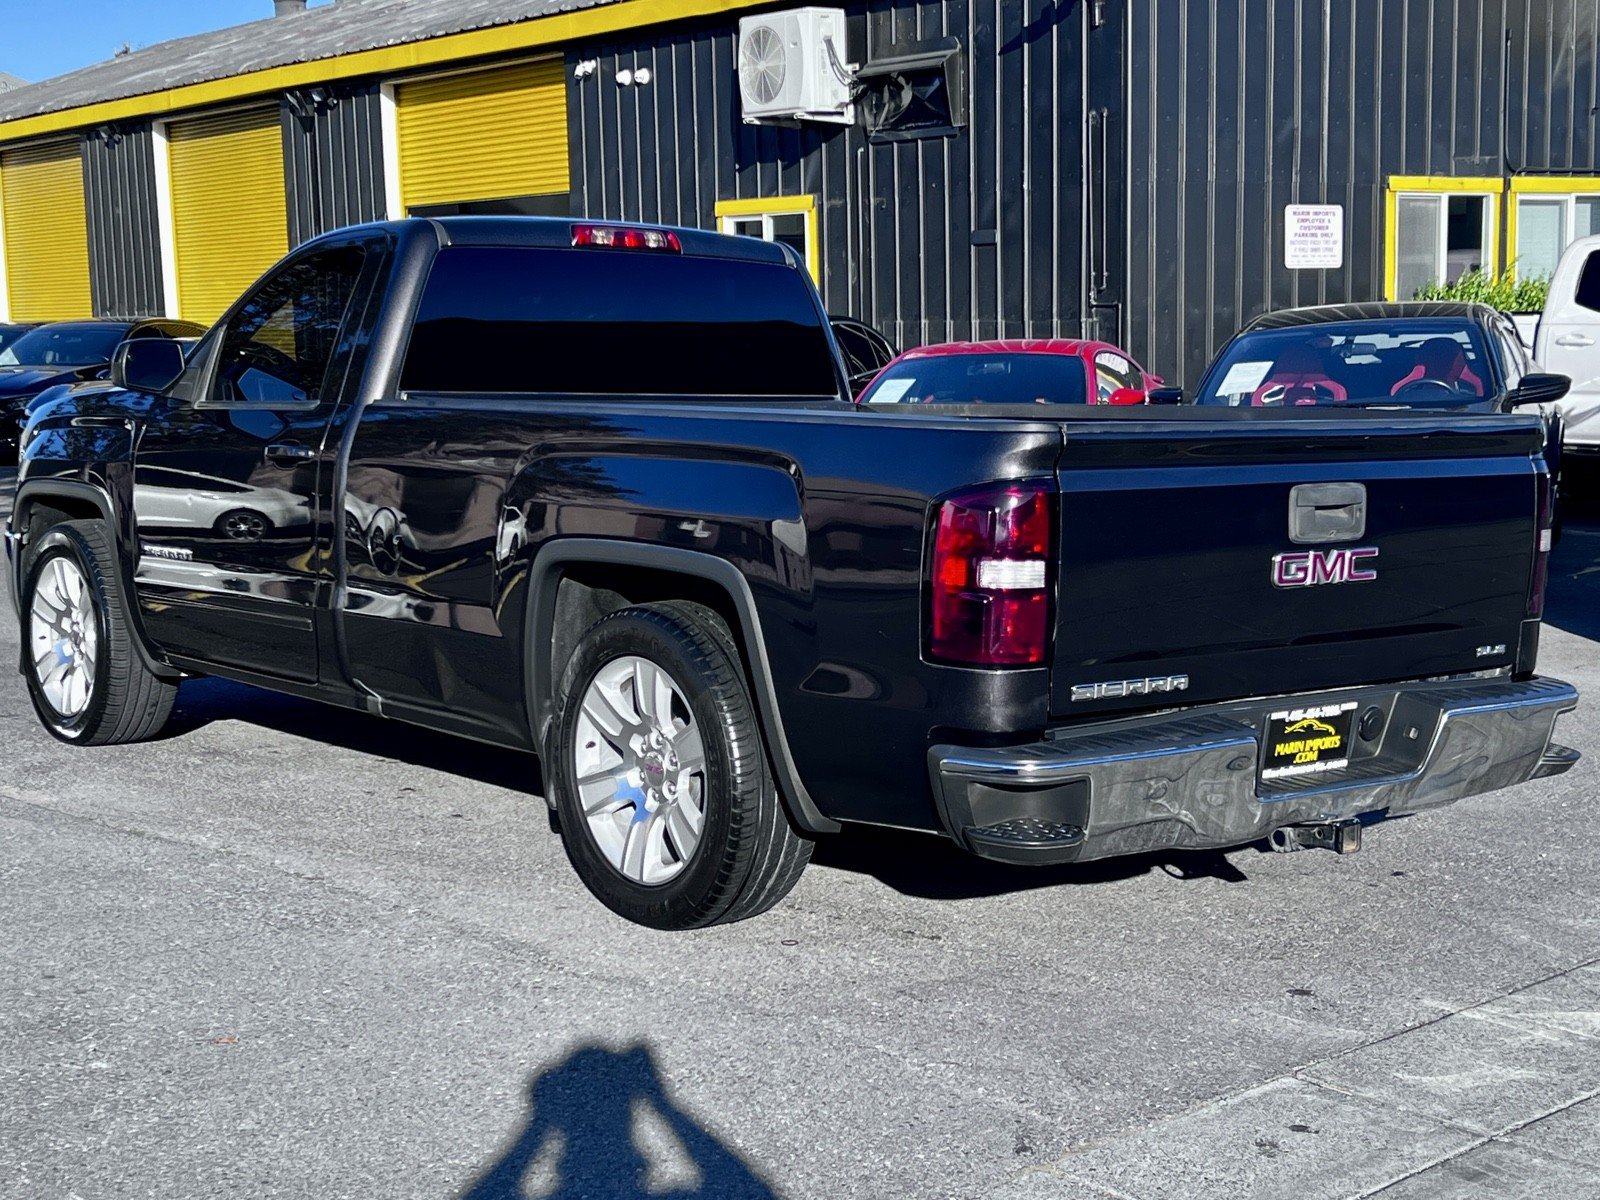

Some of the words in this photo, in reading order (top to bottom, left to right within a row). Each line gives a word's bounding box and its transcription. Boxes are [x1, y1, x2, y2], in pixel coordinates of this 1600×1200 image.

[1271, 547, 1379, 589] GMC
[1071, 674, 1189, 702] SIERRA
[1274, 741, 1304, 757] MARIN
[1305, 735, 1341, 751] IMPORTS
[1293, 751, 1318, 764] .COM
